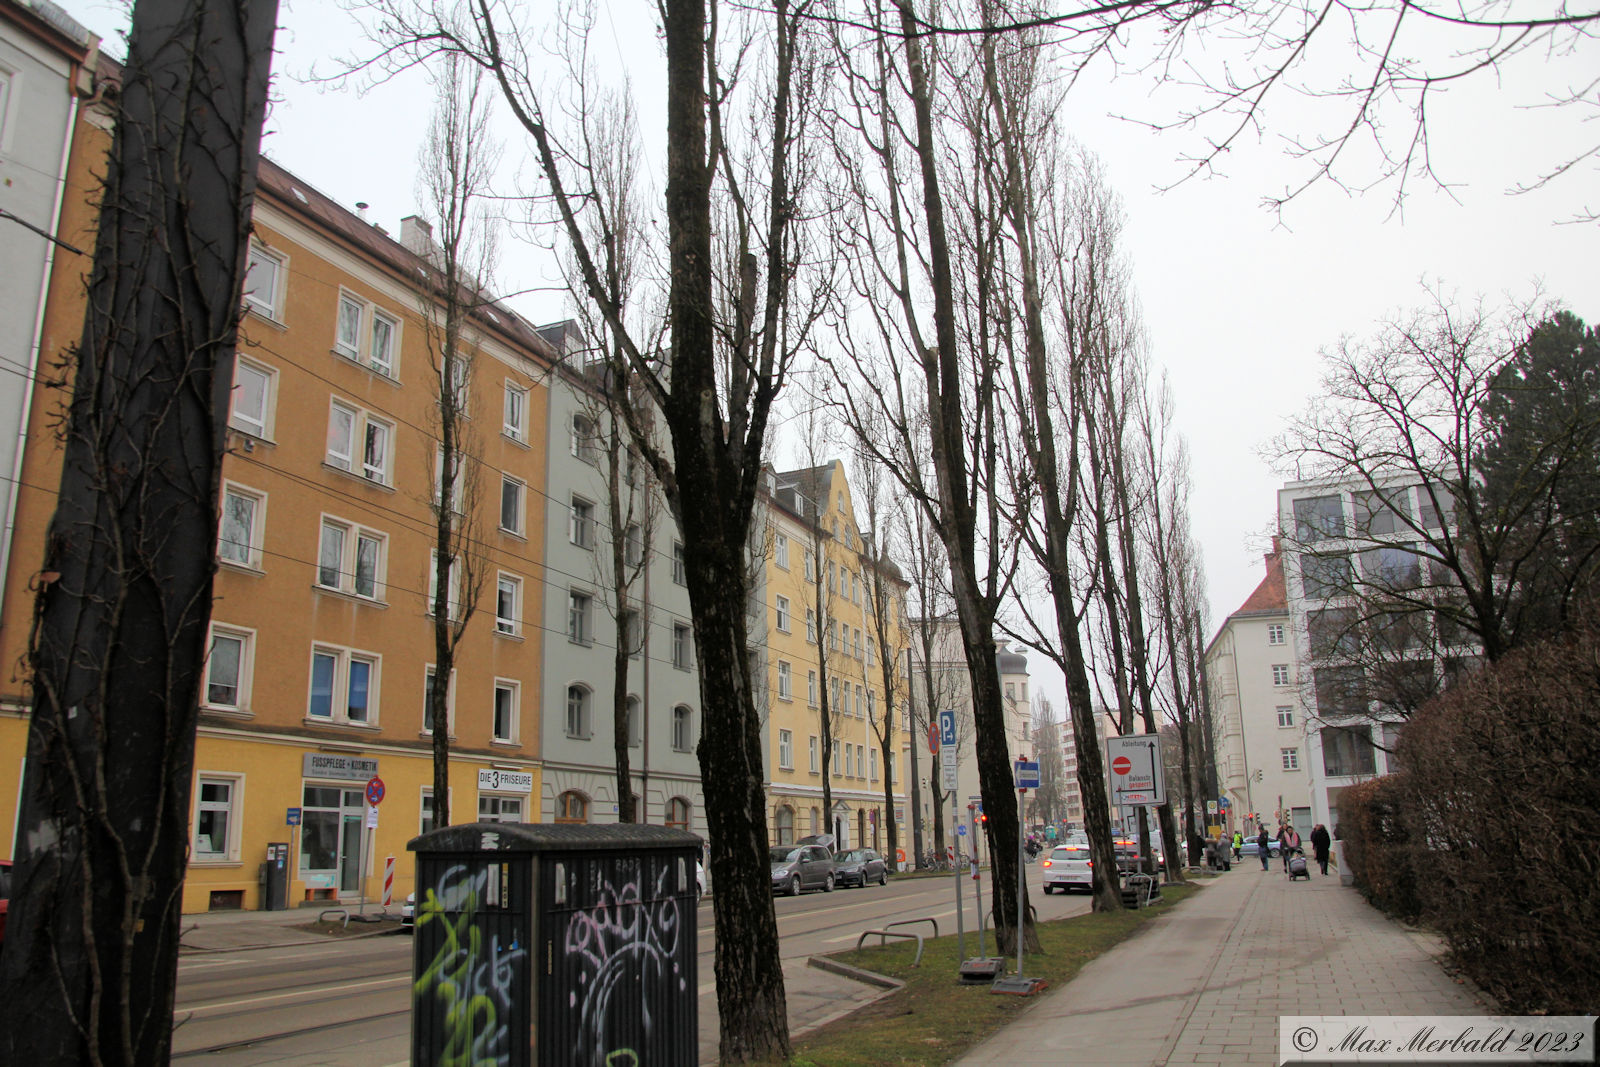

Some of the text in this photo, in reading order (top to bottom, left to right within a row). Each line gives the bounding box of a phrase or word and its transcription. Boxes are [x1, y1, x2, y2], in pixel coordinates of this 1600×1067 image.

[942, 715, 951, 741] P
[1122, 740, 1147, 748] Ableitung
[312, 756, 377, 772] FUSSPFLEGE KOSMETIK
[480, 771, 531, 789] DIE 3 FRISEURE
